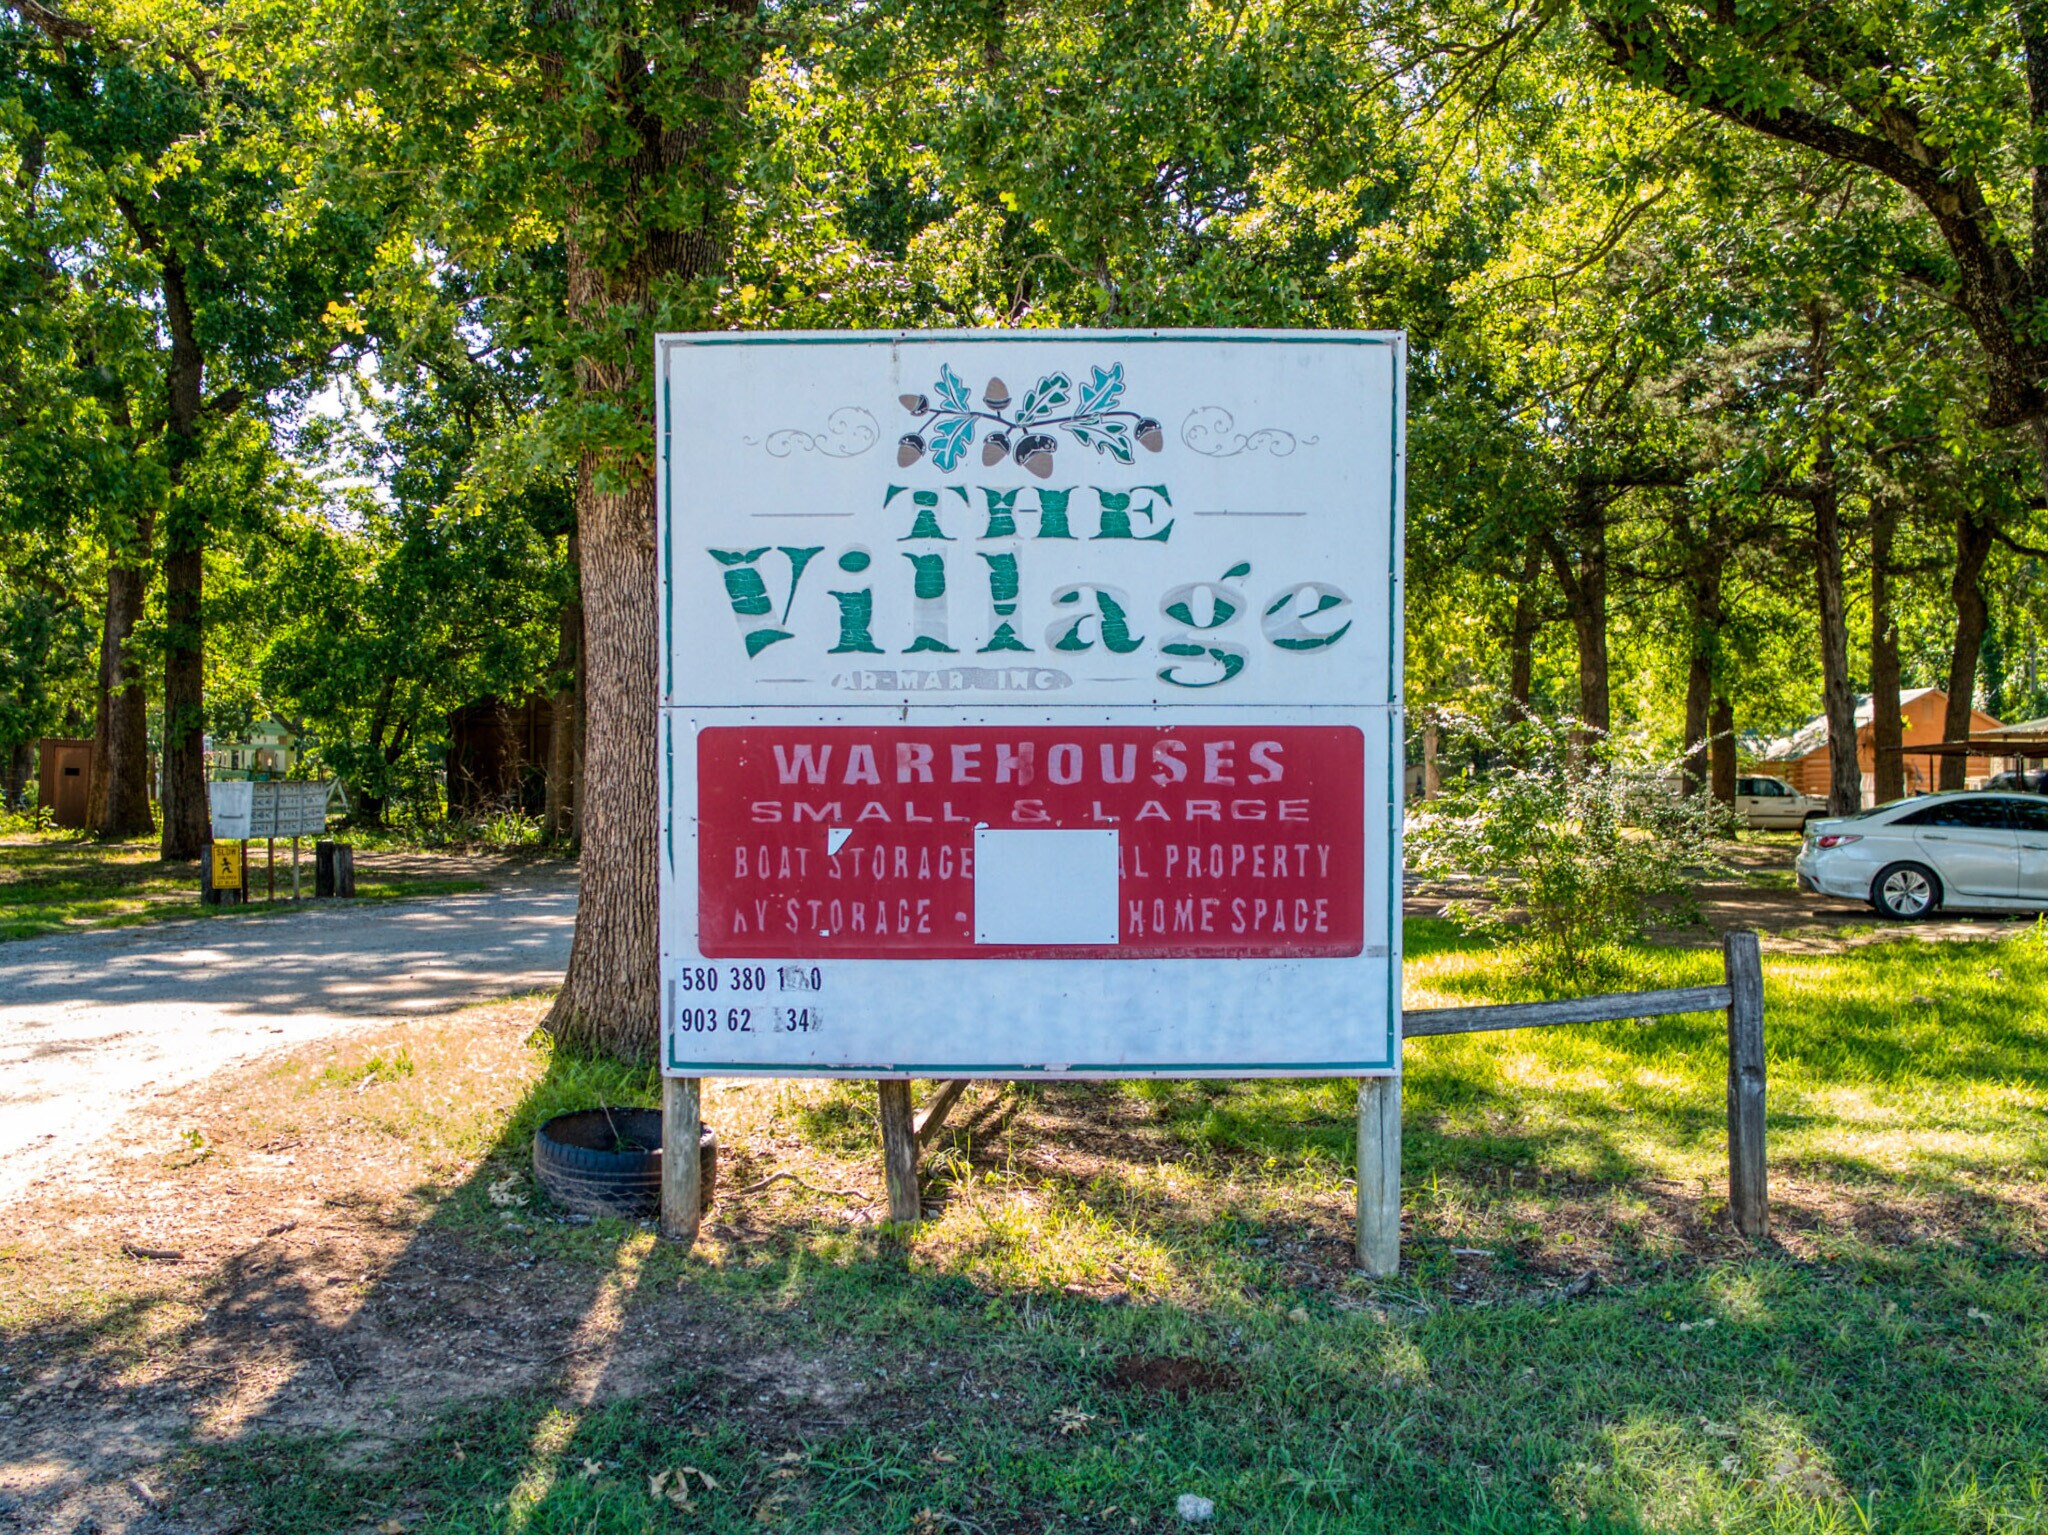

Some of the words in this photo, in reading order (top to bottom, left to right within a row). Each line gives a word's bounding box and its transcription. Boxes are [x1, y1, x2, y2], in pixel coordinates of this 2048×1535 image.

[884, 483, 1176, 544] THE
[706, 545, 1353, 688] Village
[773, 740, 1284, 787] WAREHOUSES
[751, 800, 970, 823] SMALL
[1011, 799, 1051, 822] &
[1093, 799, 1310, 821] LARGE
[735, 845, 811, 879] BOAT
[828, 845, 973, 880] STORAGE
[1166, 843, 1330, 879] PROPERTY
[786, 898, 931, 934] STORAGE
[1129, 898, 1217, 934] HOME
[1231, 897, 1328, 933] SPACE
[682, 967, 718, 991] 580
[730, 967, 765, 991] 380
[777, 966, 822, 991] 10
[682, 1008, 717, 1032] 903
